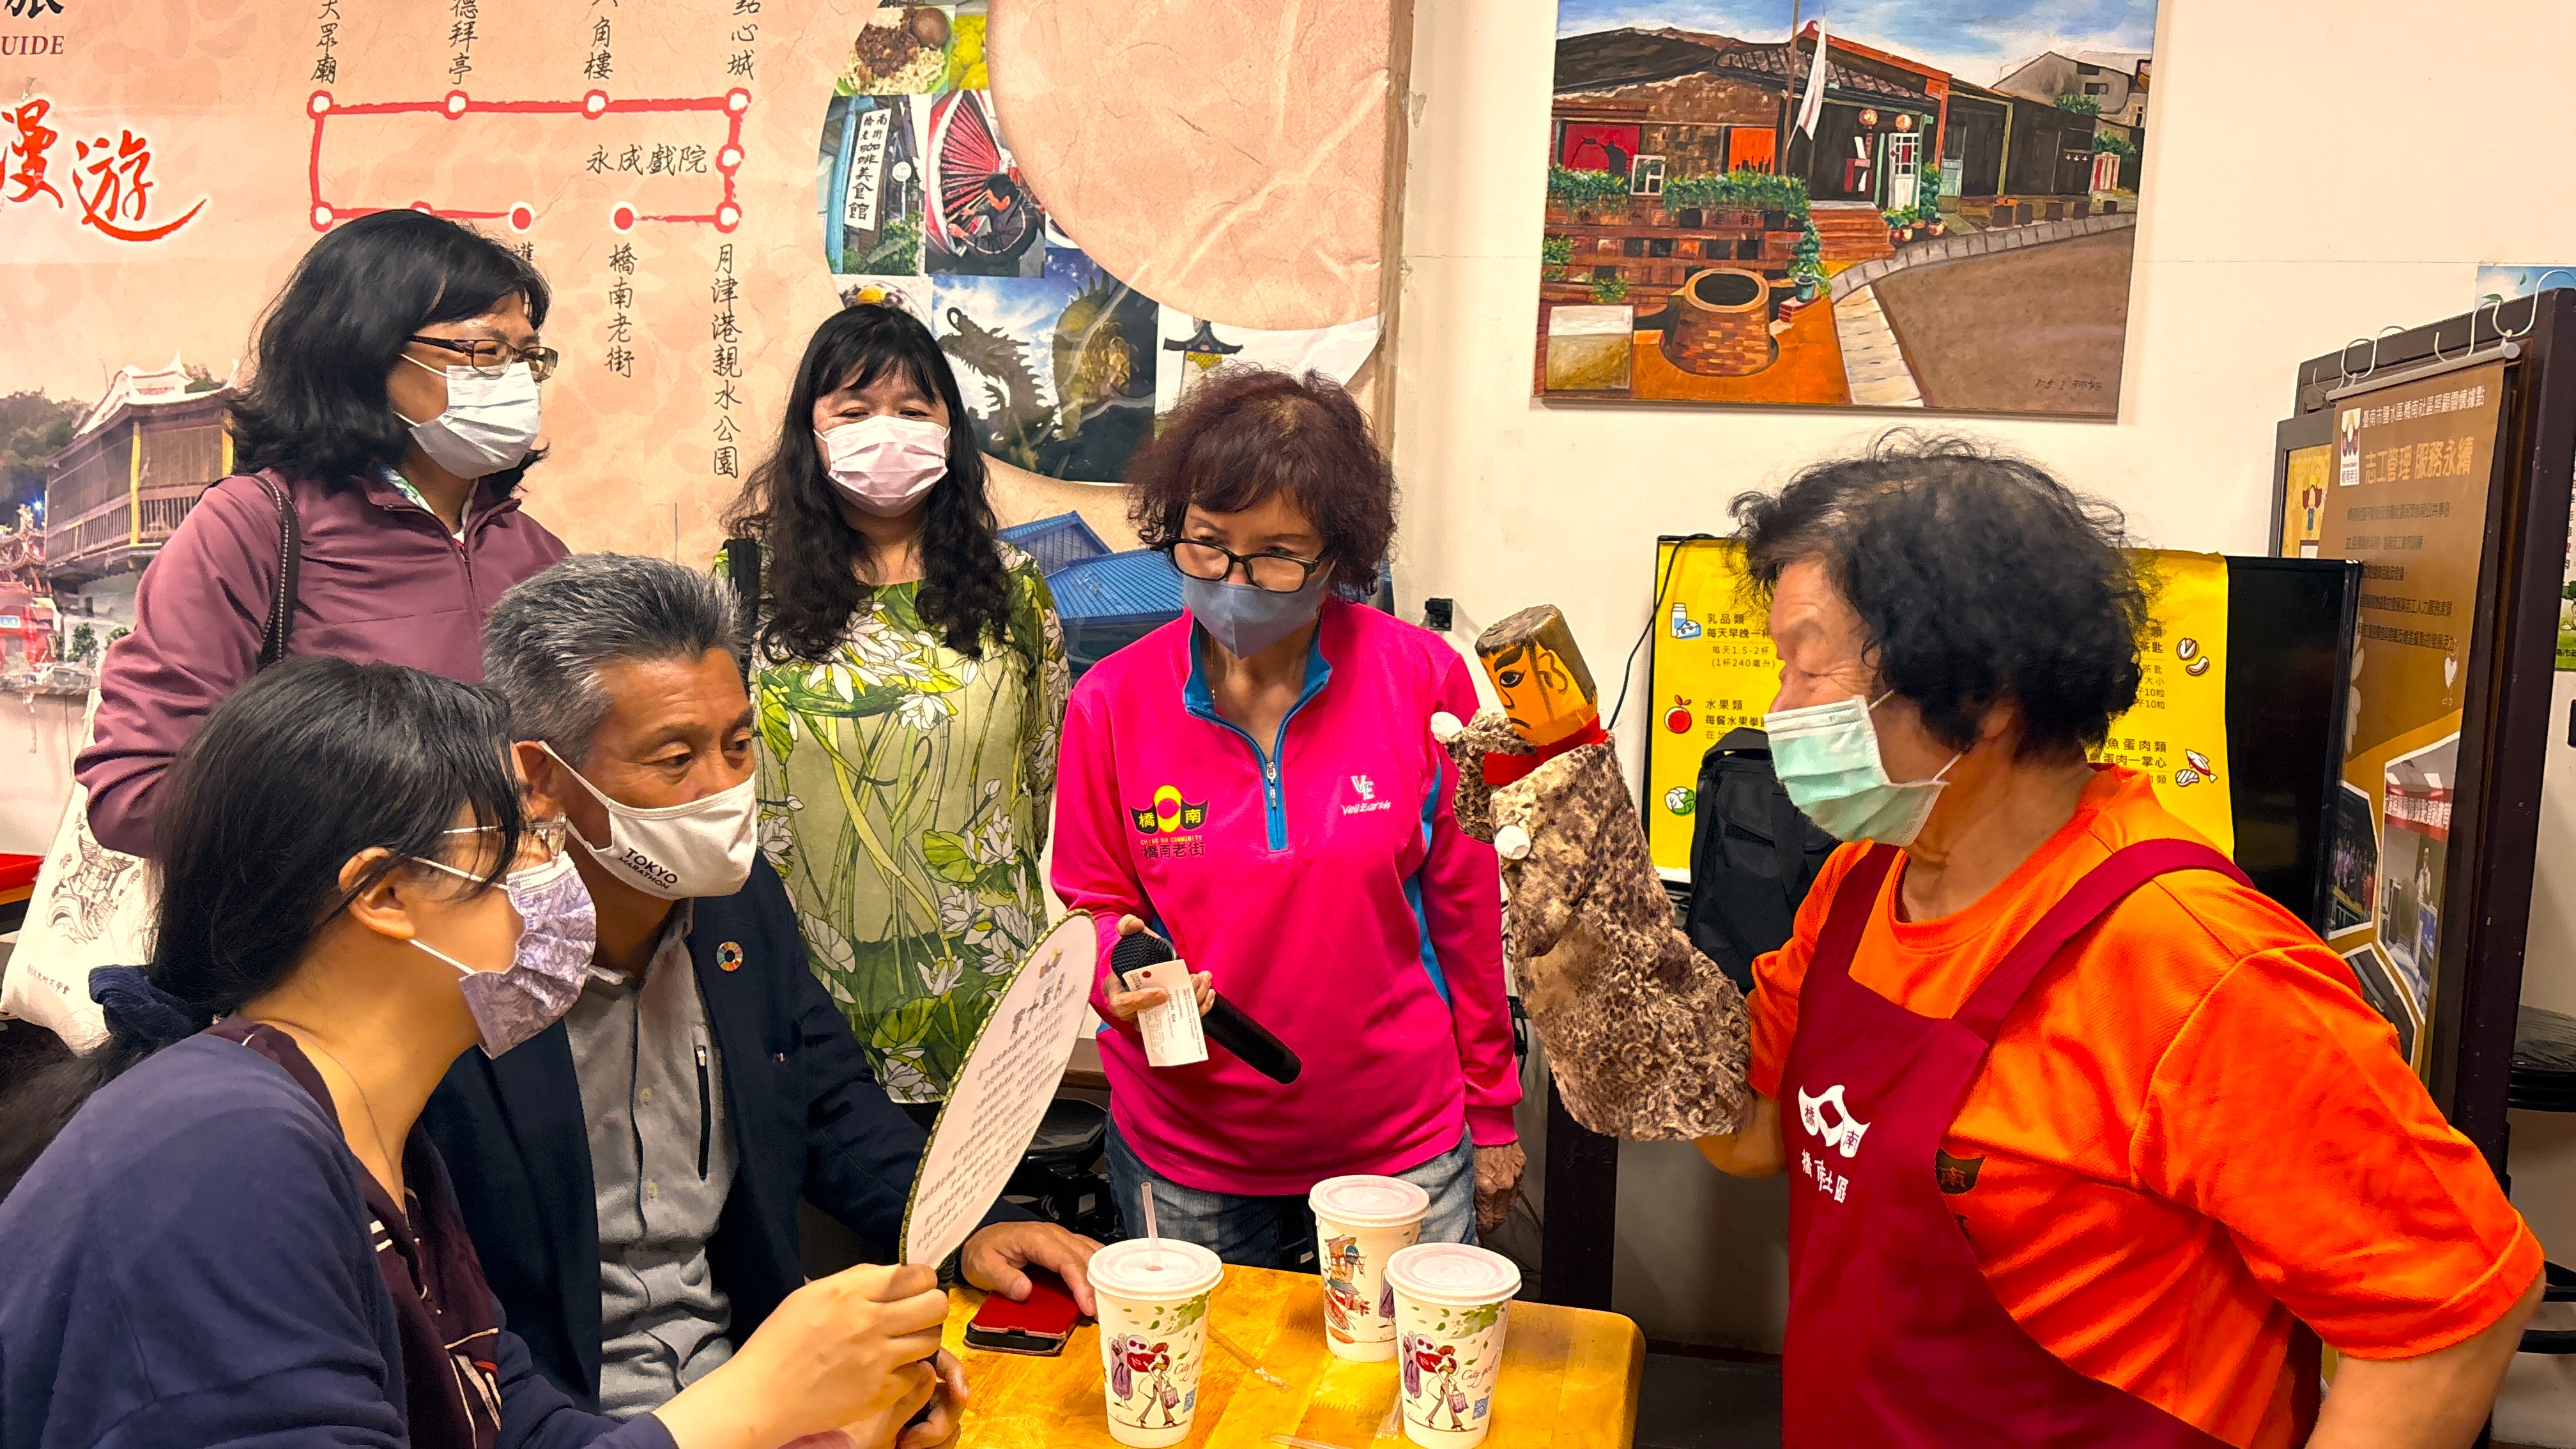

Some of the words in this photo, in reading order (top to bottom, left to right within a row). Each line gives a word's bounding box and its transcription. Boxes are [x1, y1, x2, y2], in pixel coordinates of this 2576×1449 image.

[1, 35, 65, 56] UIDE
[584, 0, 618, 80] 角樓
[586, 143, 707, 176] 永成戲院
[604, 243, 638, 378] 橋南老街
[710, 243, 743, 479] 月津港親水公園
[2365, 445, 2412, 484] 志工管理
[2414, 436, 2475, 480] 服務永續
[1706, 613, 1745, 625] 乳品類
[1705, 699, 1744, 711] 水果類
[1138, 812, 1155, 828] 橋
[1184, 808, 1202, 824] 南
[626, 847, 678, 885] TOKYO
[1144, 841, 1206, 859] 橋南老街
[618, 856, 670, 890] MARATHON
[1843, 1130, 1860, 1153] 南
